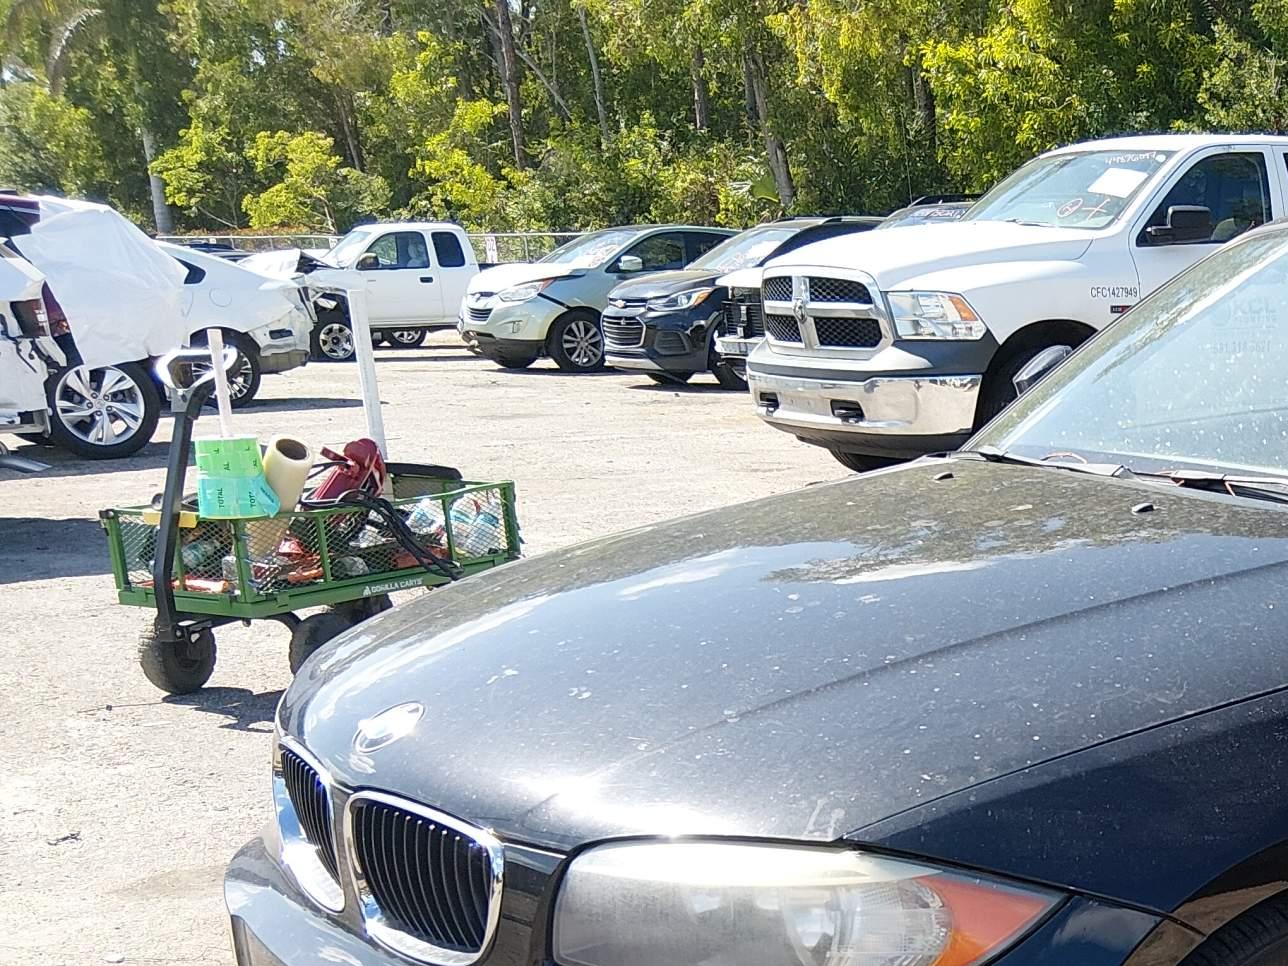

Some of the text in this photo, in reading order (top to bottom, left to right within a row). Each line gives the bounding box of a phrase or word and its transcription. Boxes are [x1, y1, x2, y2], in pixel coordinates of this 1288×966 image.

[1090, 286, 1138, 298] CFC1427949
[249, 491, 257, 509] TOT
[371, 578, 422, 594] GORILLA CARTS
